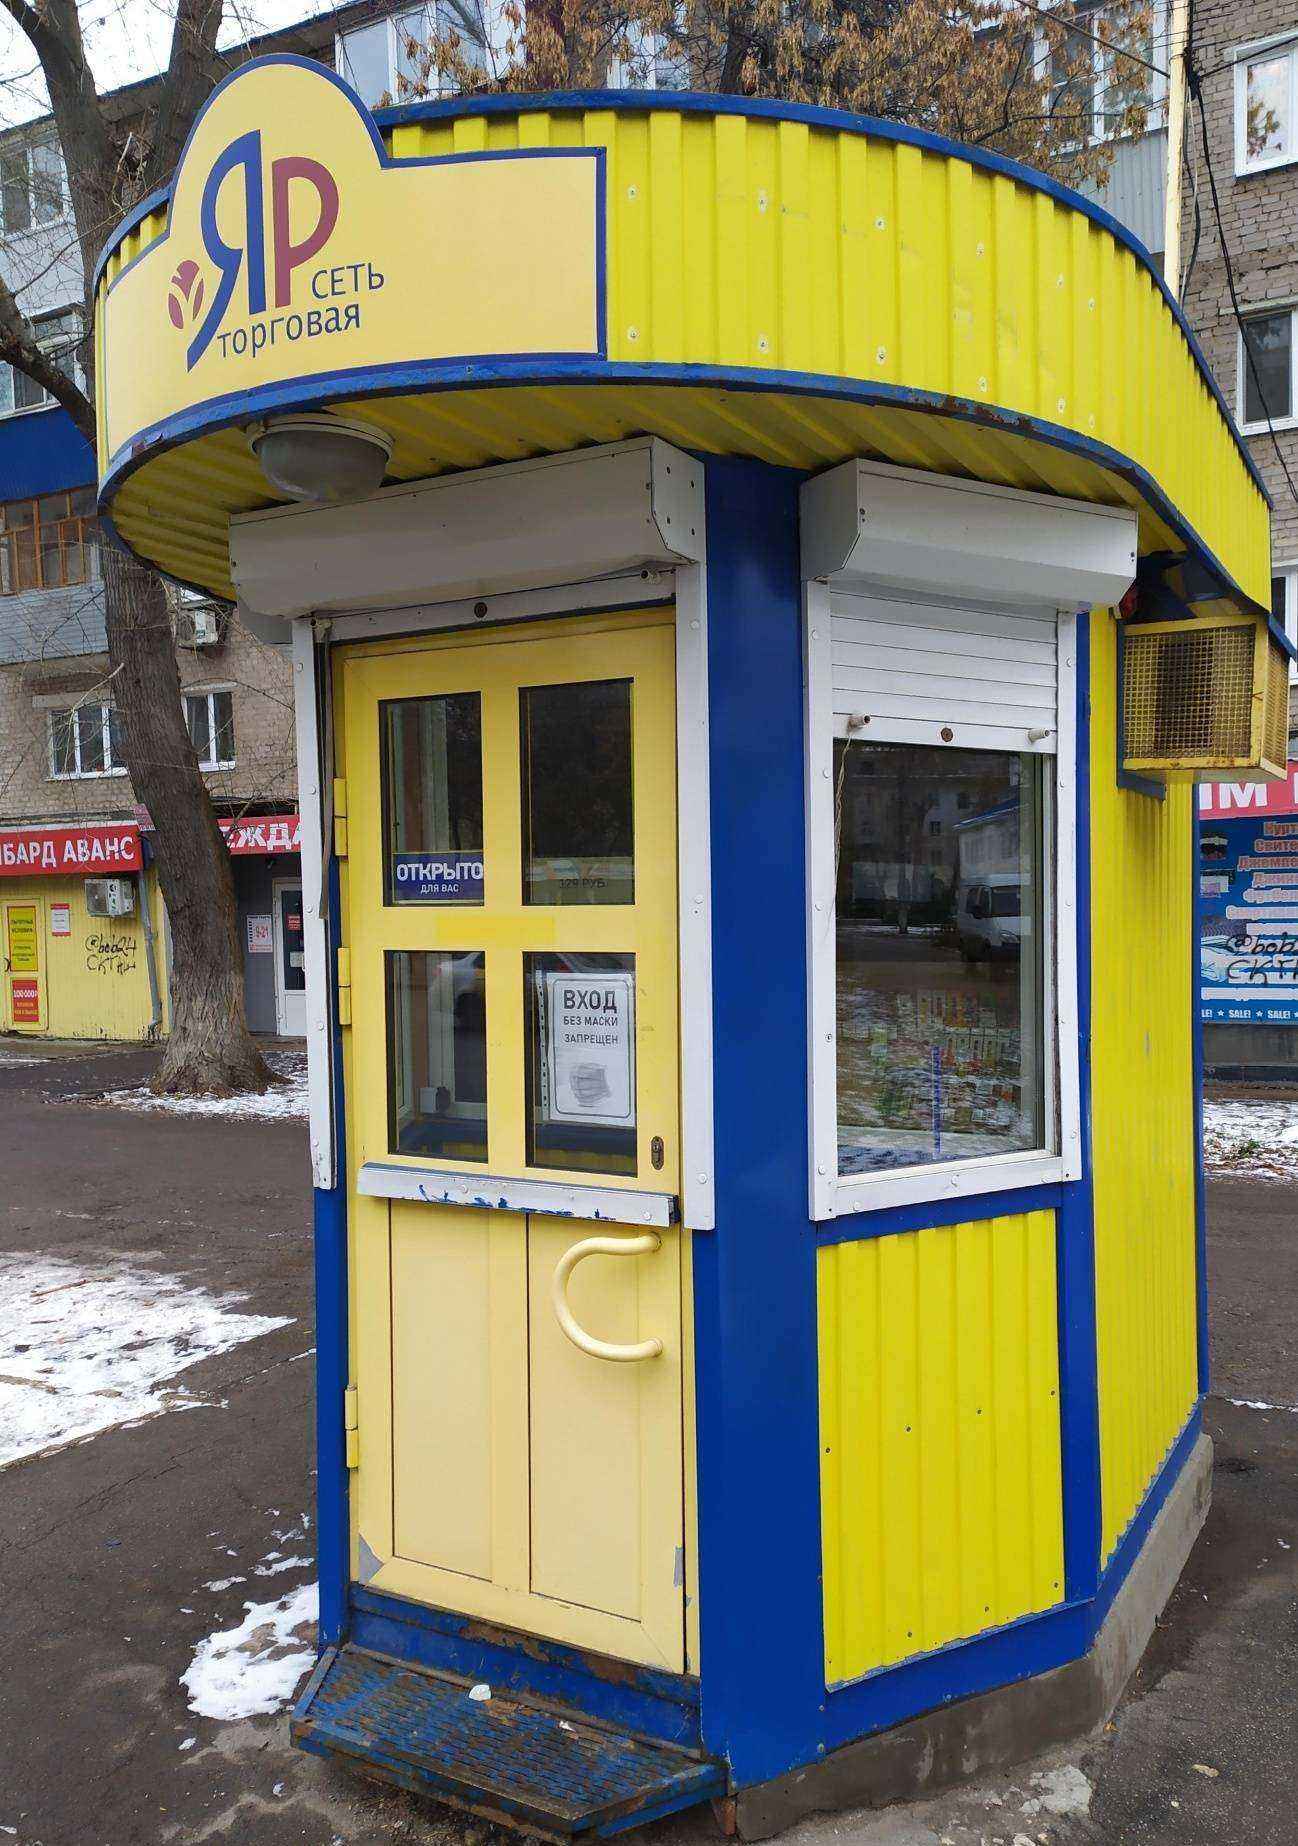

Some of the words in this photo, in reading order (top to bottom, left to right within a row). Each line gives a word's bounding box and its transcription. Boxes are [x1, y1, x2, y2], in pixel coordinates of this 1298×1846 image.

[187, 129, 339, 373] ЯР
[217, 303, 360, 358] торговая
[0, 842, 57, 869] БАРД
[63, 836, 135, 863] АВАНС
[396, 861, 484, 882] ОТКРЫТО
[420, 884, 439, 894] ДЛЯ
[441, 883, 460, 893] ВАС
[563, 989, 618, 1014] ВХОД
[563, 1015, 582, 1026] БЕЗ
[584, 1016, 618, 1027] МАСКИ
[1228, 1009, 1251, 1019] SALE!
[1267, 1009, 1291, 1019] SALE!
[564, 1033, 619, 1047] ЗАПРЕЩЕН
